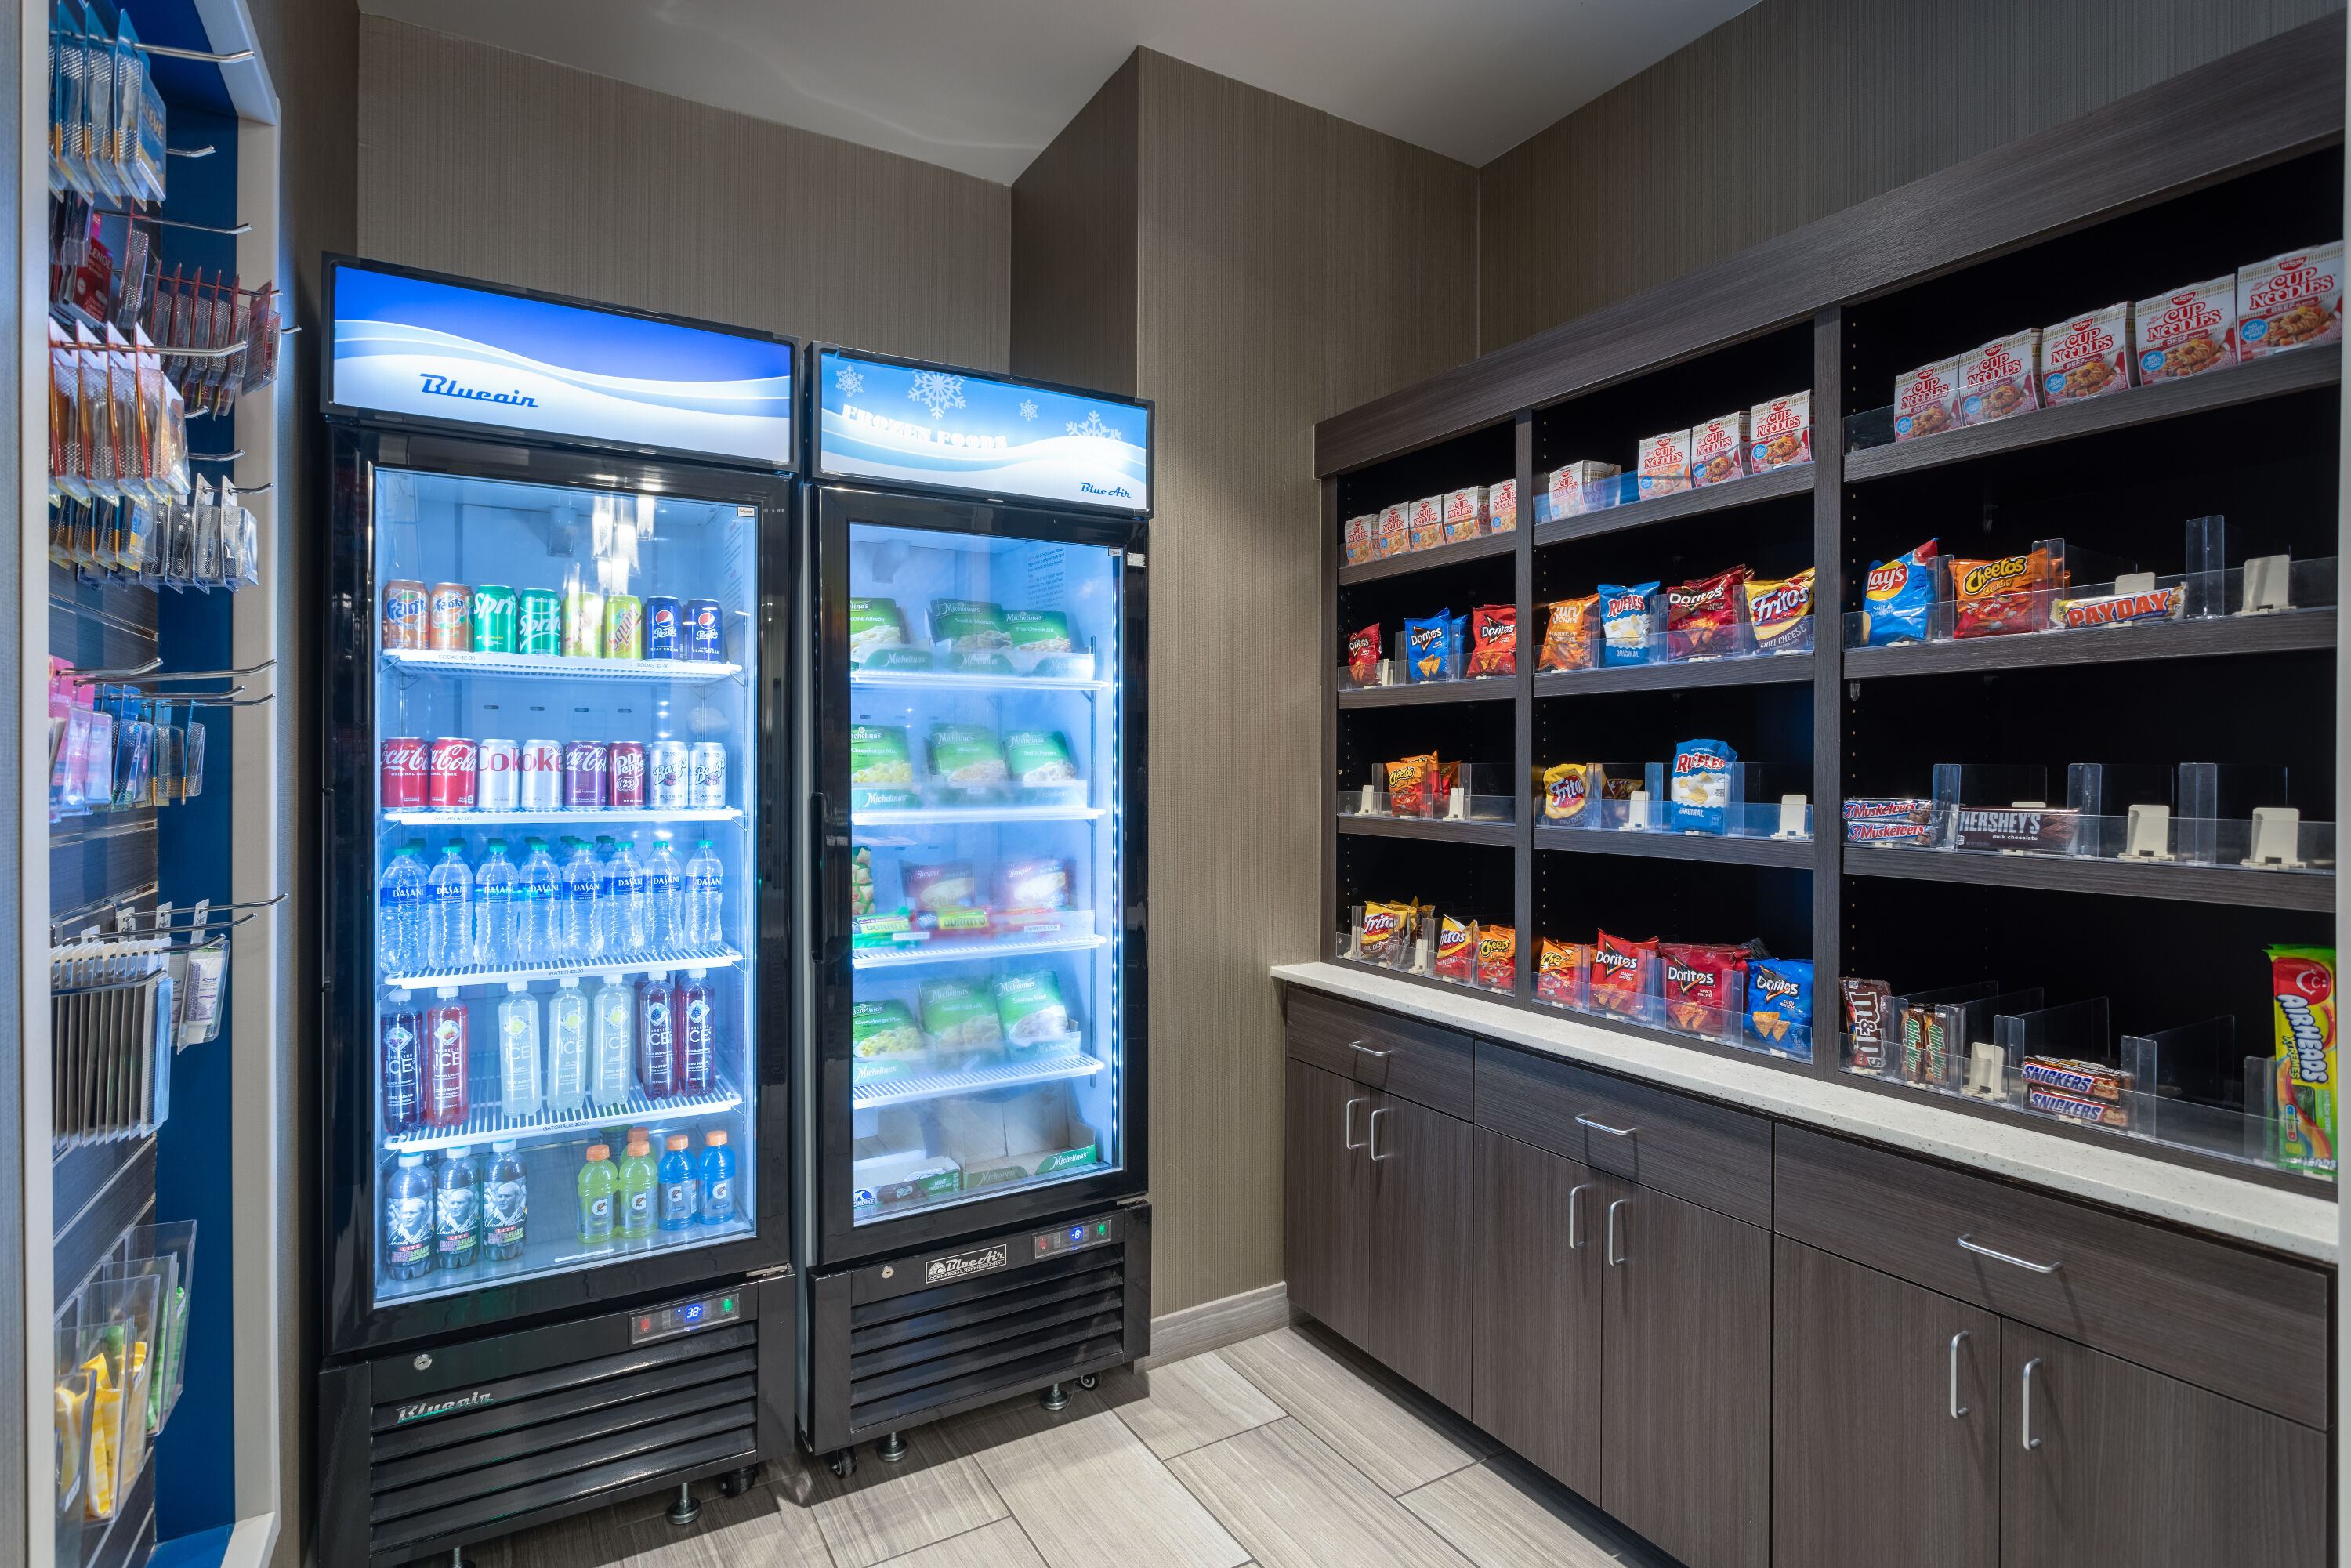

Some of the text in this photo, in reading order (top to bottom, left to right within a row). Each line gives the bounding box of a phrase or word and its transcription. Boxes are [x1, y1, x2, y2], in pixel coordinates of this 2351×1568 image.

[2280, 258, 2304, 269] NISSIN
[2269, 266, 2317, 291] CUP
[2173, 295, 2194, 304] NISSIN
[2250, 274, 2334, 310] NOODLES
[2164, 302, 2205, 323] CUP
[2271, 302, 2295, 313] BEEF
[2147, 310, 2222, 342] NOODLES
[2066, 328, 2102, 348] CUP
[2167, 335, 2188, 345] BEEF
[2051, 335, 2114, 364] NOODLES
[1979, 353, 2009, 371] CUP
[2067, 358, 2085, 368] BEEF
[1967, 360, 2022, 388] NOODLES
[419, 373, 539, 407] Blueair
[1913, 378, 1940, 395] CUP
[1982, 382, 1996, 391] BEEF
[1901, 383, 1949, 410] NOODLES
[1767, 409, 1792, 423] CUP
[1913, 404, 1927, 413] BEEF
[842, 404, 1008, 449] FROZEN FOODS
[1757, 415, 1801, 437] NOODLES
[1704, 430, 1725, 444] CUP
[1654, 446, 1675, 458] CUP
[1697, 436, 1732, 456] NOODLES
[1644, 451, 1683, 469] NOODLES
[1081, 482, 1131, 498] BlueAir
[1447, 505, 1473, 519] NOODLES
[1454, 499, 1469, 509] CUP
[1388, 514, 1400, 523] CUP
[1414, 513, 1437, 527] NOODLES
[1418, 509, 1433, 518] CUP
[1382, 520, 1405, 534] NOODLES
[1867, 563, 1906, 592] Lay's
[1964, 556, 2028, 595] Cheetos
[1982, 578, 2013, 596] Crunchy
[436, 598, 464, 613] Fanta
[1669, 588, 1723, 606] Doritos
[1751, 585, 1810, 626] Fritos
[1608, 596, 1645, 617] RUFFLES
[2068, 591, 2168, 627] PAYDAY
[607, 602, 639, 651] Squirt
[1005, 612, 1043, 624] Michelina's
[1411, 627, 1443, 646] Doritos
[1482, 625, 1516, 638] Doritos
[1760, 625, 1806, 649] CHILI CHEESE
[1616, 650, 1639, 658] ORIGINAL
[1009, 735, 1045, 747] Michelina's
[628, 752, 642, 764] Dr
[1676, 753, 1726, 773] RUFFLES
[1389, 766, 1415, 787] Cheetos
[862, 791, 907, 808] Michelina's
[1549, 776, 1585, 807] Fritos
[1679, 808, 1704, 817] ORIGINAL
[1844, 802, 1917, 818] 3 Musketeers
[1960, 813, 2041, 834] HERSHEY'S
[1849, 825, 1925, 840] 3 Musketeers
[531, 884, 558, 893] DASANI
[574, 882, 602, 891] DASANI
[618, 877, 643, 886] DASANI
[654, 875, 679, 885] DASANI
[697, 876, 723, 885] DASANI
[393, 887, 424, 897] DASANI
[437, 884, 468, 895] DASANI
[484, 885, 513, 895] DASANI
[943, 917, 986, 927] BURRITO
[1480, 940, 1510, 955] Cheetos
[1596, 950, 1638, 970] Doritos
[1668, 965, 1715, 984] Doritos
[997, 981, 1035, 996] Michelina's
[1757, 975, 1800, 995] Doritos
[929, 987, 969, 1003] Michelina's
[560, 1040, 584, 1054] ICE
[605, 1036, 628, 1049] ICE
[2275, 994, 2328, 1083] AIRHEADS
[435, 1052, 461, 1067] ICE
[505, 1045, 532, 1060] ICE
[2282, 1036, 2300, 1080] XTREMES
[386, 1057, 413, 1074] ICE
[854, 1066, 897, 1082] Michelina's
[2022, 1063, 2093, 1093] SNICKERS
[2031, 1093, 2104, 1121] SNICKERS
[543, 1123, 574, 1132] GATORADE
[1050, 1151, 1089, 1170] Michelina's
[976, 1169, 1016, 1186] Michelina's
[668, 1186, 683, 1203] G
[712, 1182, 727, 1200] G
[592, 1198, 608, 1216] G
[631, 1193, 646, 1211] G
[929, 1260, 1004, 1280] COMMERCIAL REFRIGERATION
[945, 1251, 1005, 1272] BlueAir
[686, 1306, 701, 1319] 38
[397, 1392, 494, 1423] Blueair
